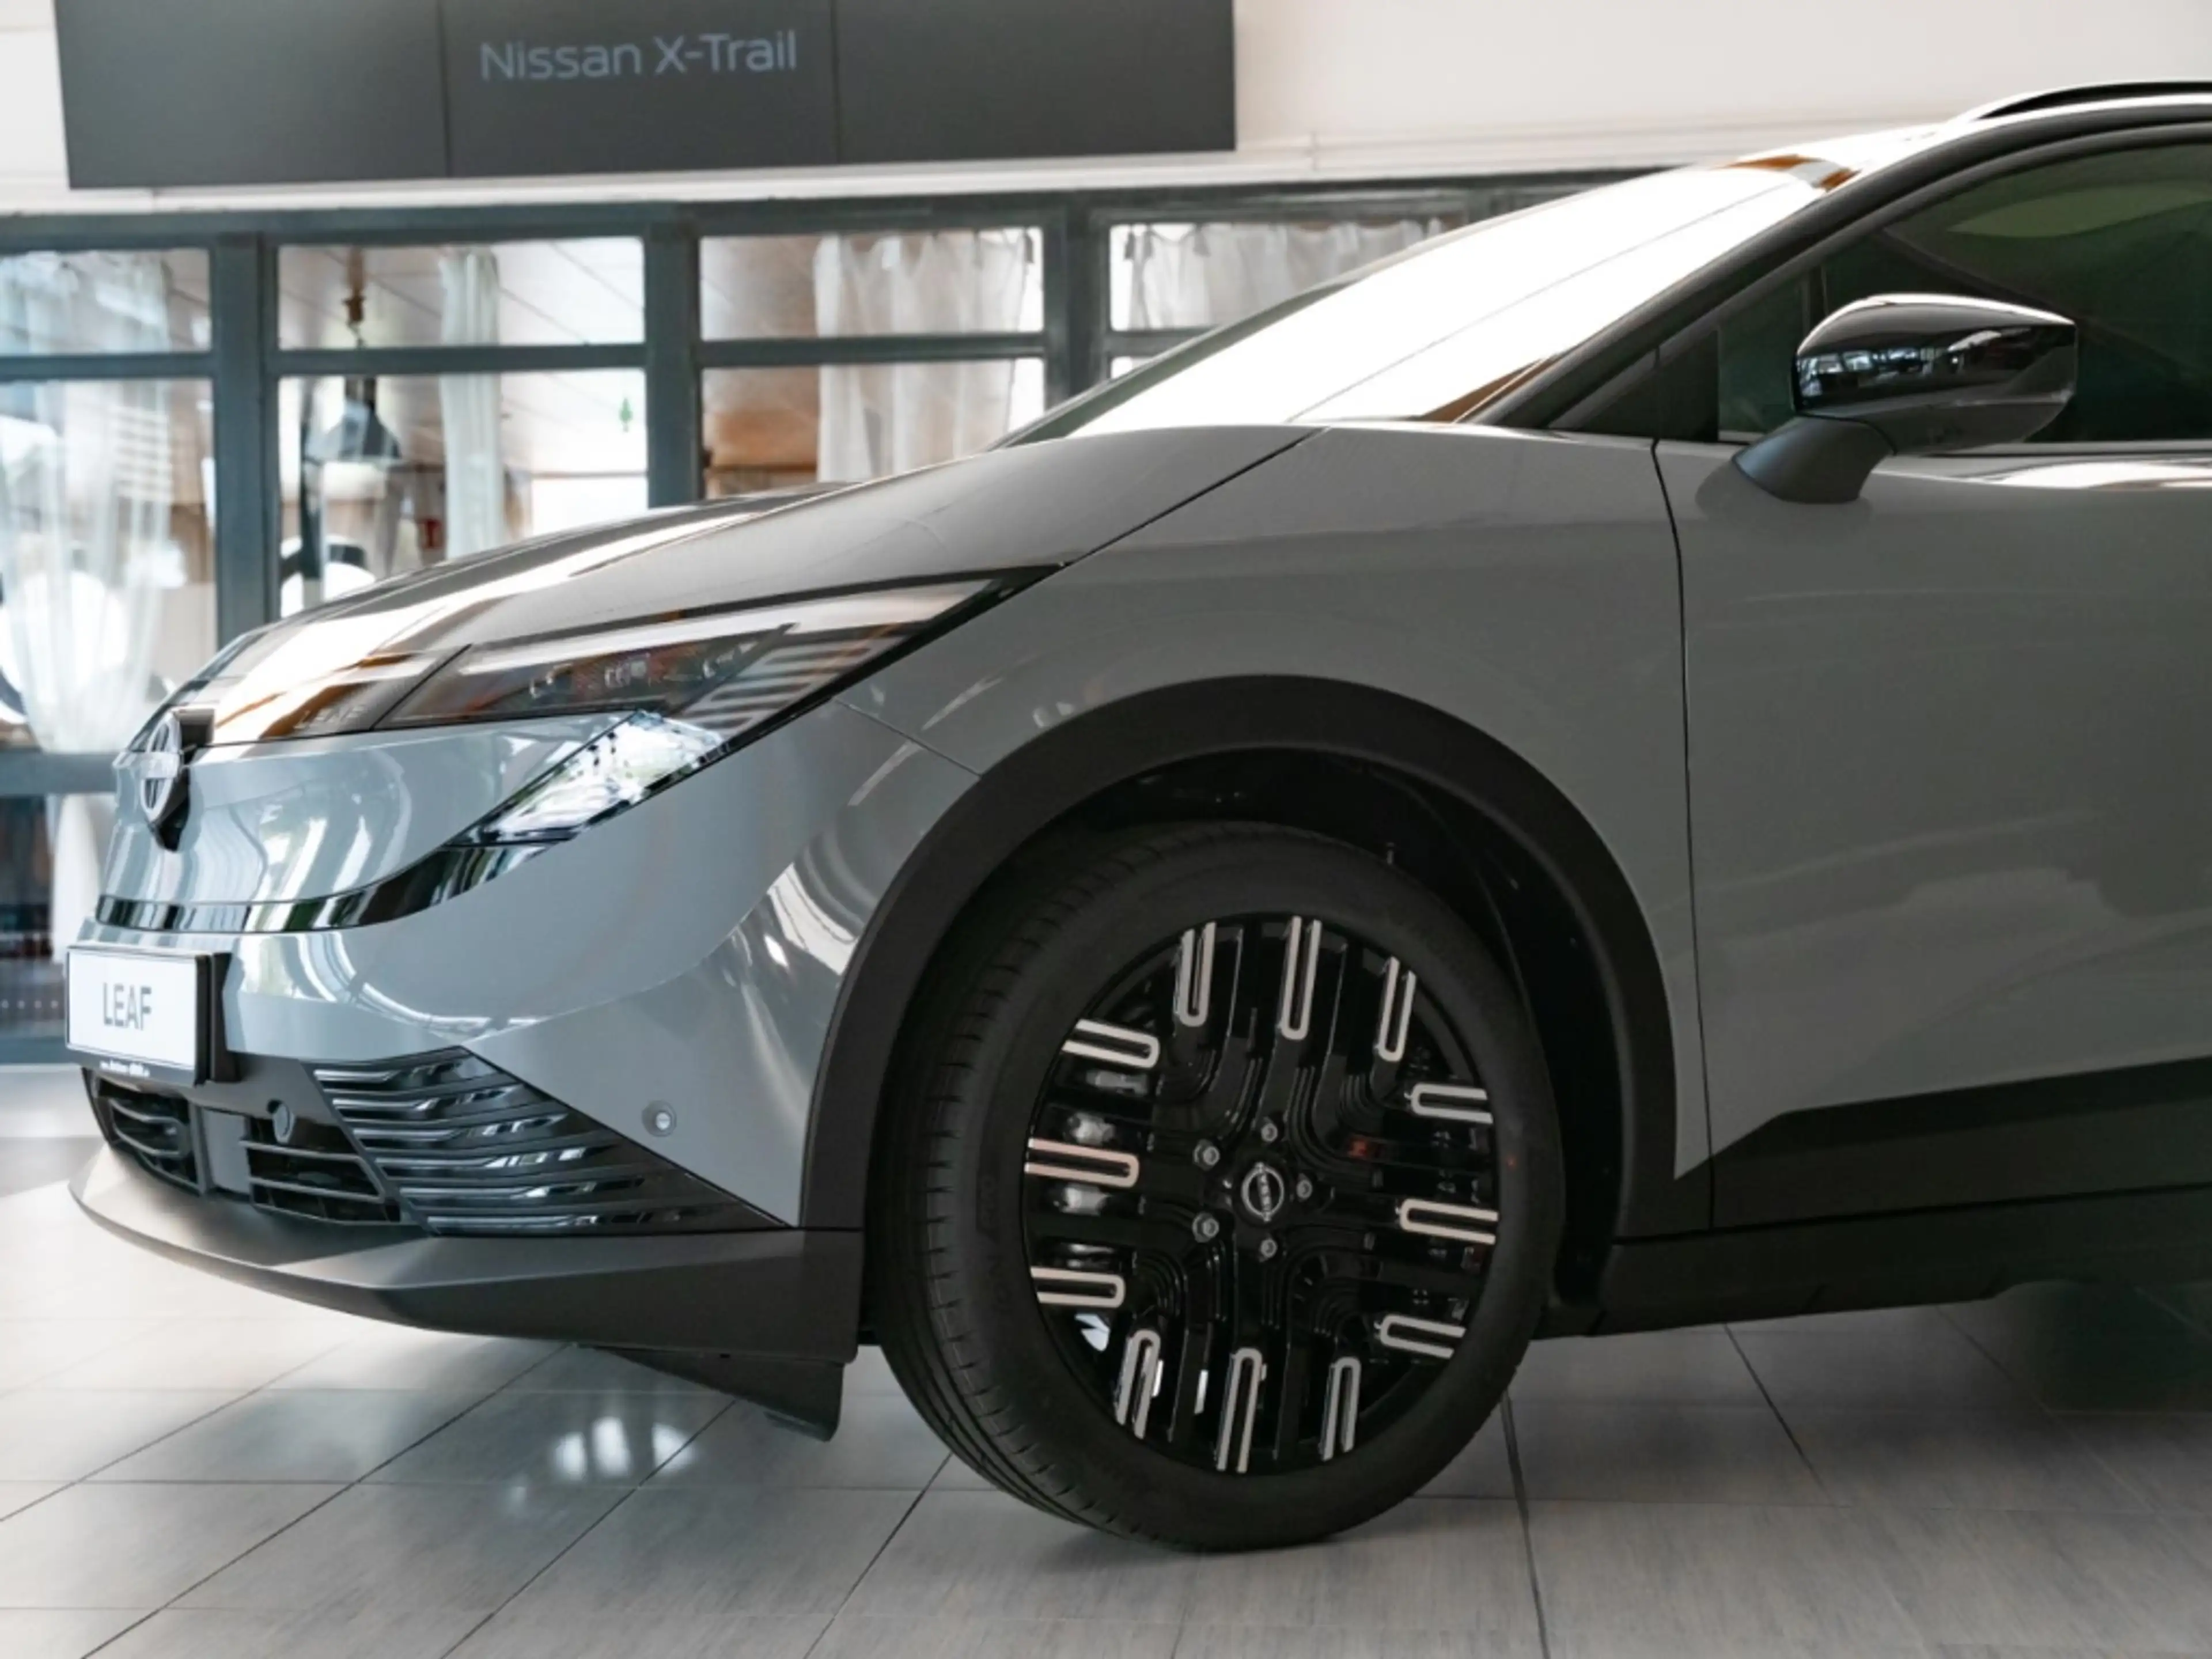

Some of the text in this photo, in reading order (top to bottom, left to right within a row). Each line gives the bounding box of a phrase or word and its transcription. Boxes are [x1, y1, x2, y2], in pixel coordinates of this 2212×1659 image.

[480, 30, 797, 81] Nissan X-Trail
[103, 982, 152, 1031] LEAF
